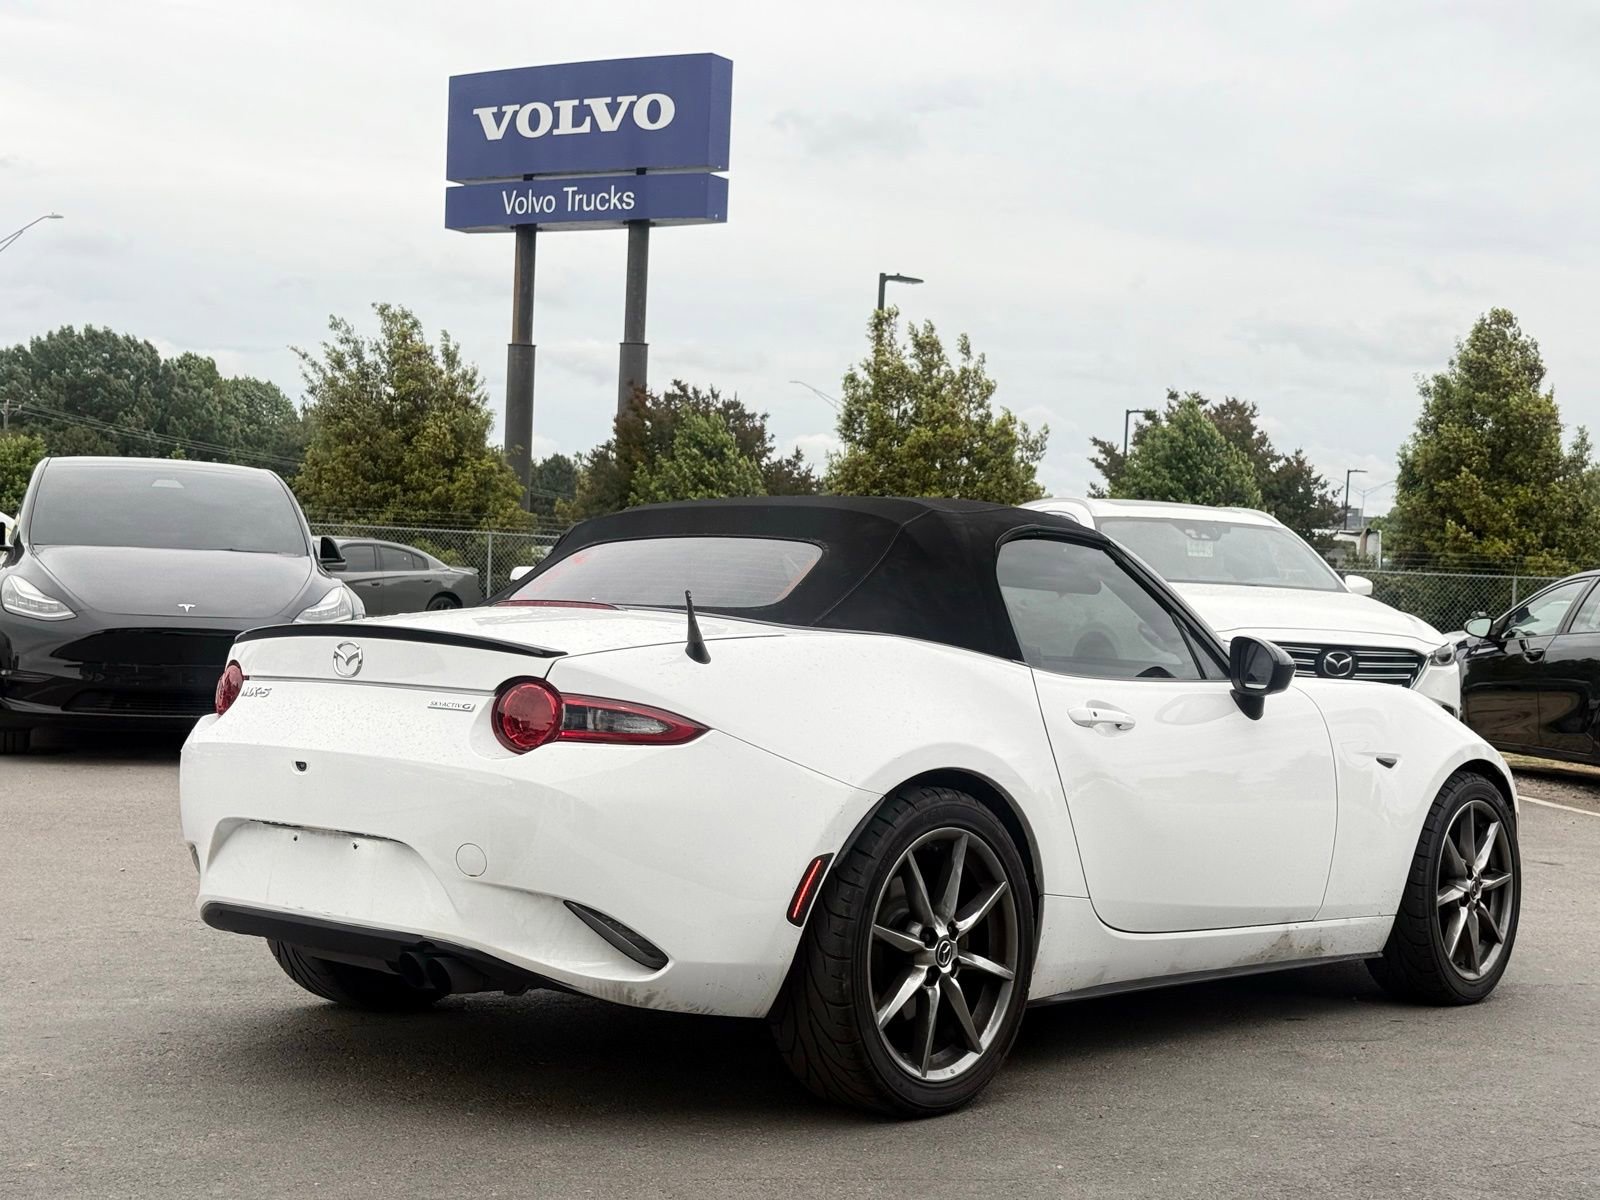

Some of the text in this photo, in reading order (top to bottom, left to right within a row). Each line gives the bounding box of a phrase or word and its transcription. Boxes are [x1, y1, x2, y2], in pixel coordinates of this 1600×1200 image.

[473, 93, 676, 141] VOLVO
[502, 184, 635, 215] Volvo Trucks
